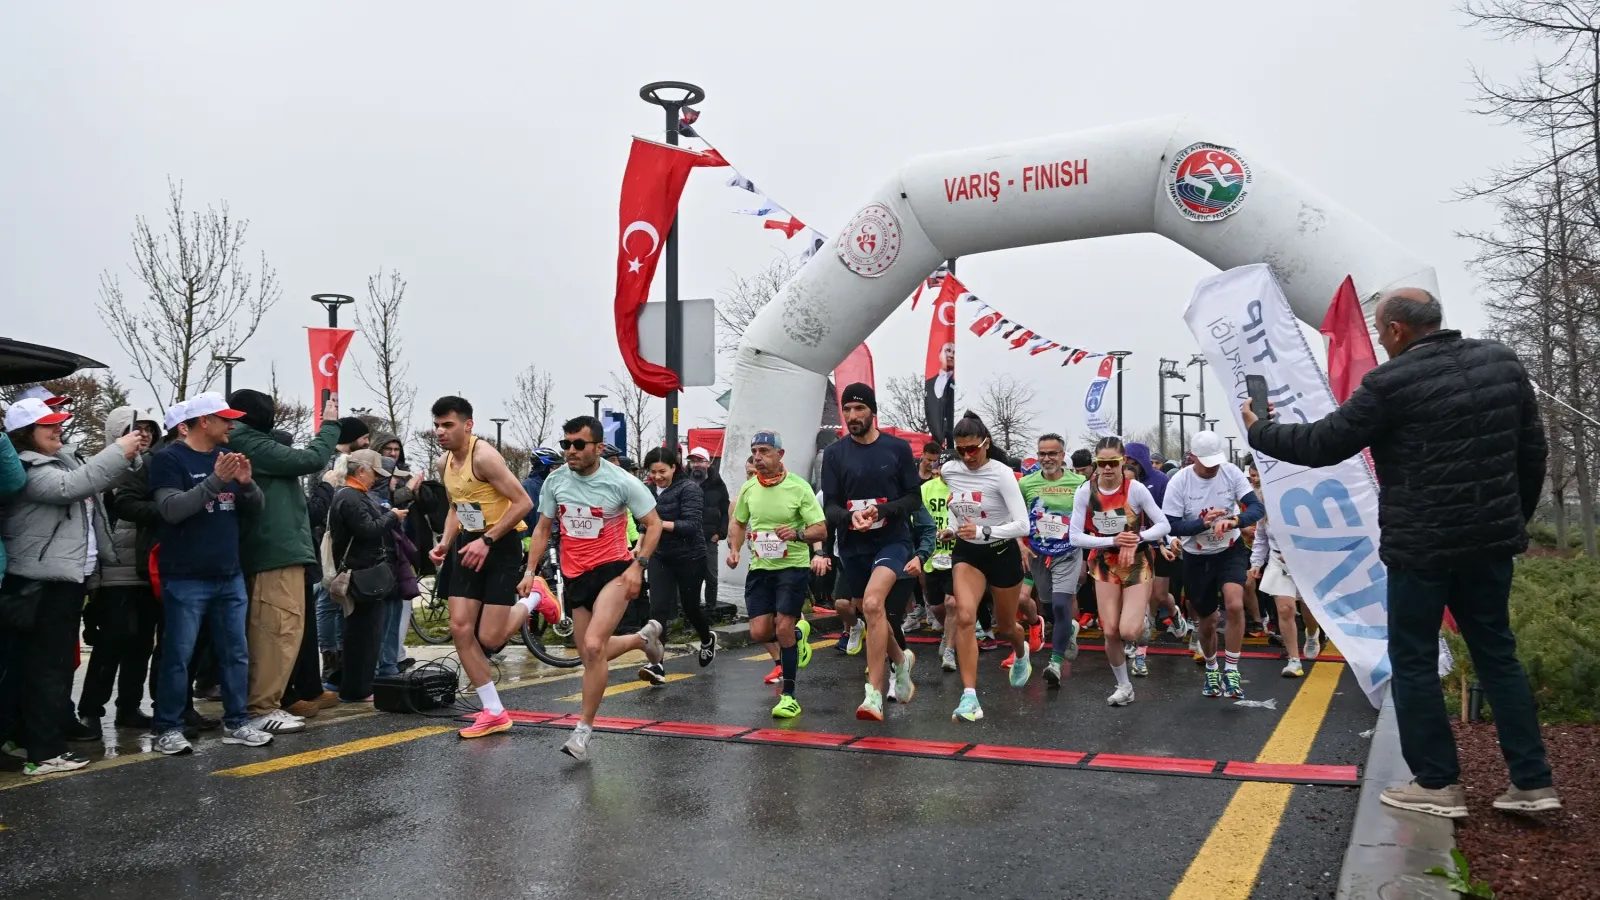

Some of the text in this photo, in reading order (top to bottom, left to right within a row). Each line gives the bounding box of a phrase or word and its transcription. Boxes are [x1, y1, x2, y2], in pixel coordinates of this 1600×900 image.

[944, 170, 1000, 203] VARIŞ
[1022, 158, 1088, 193] FINISH
[570, 519, 592, 530] 1040
[761, 543, 778, 552] 1189
